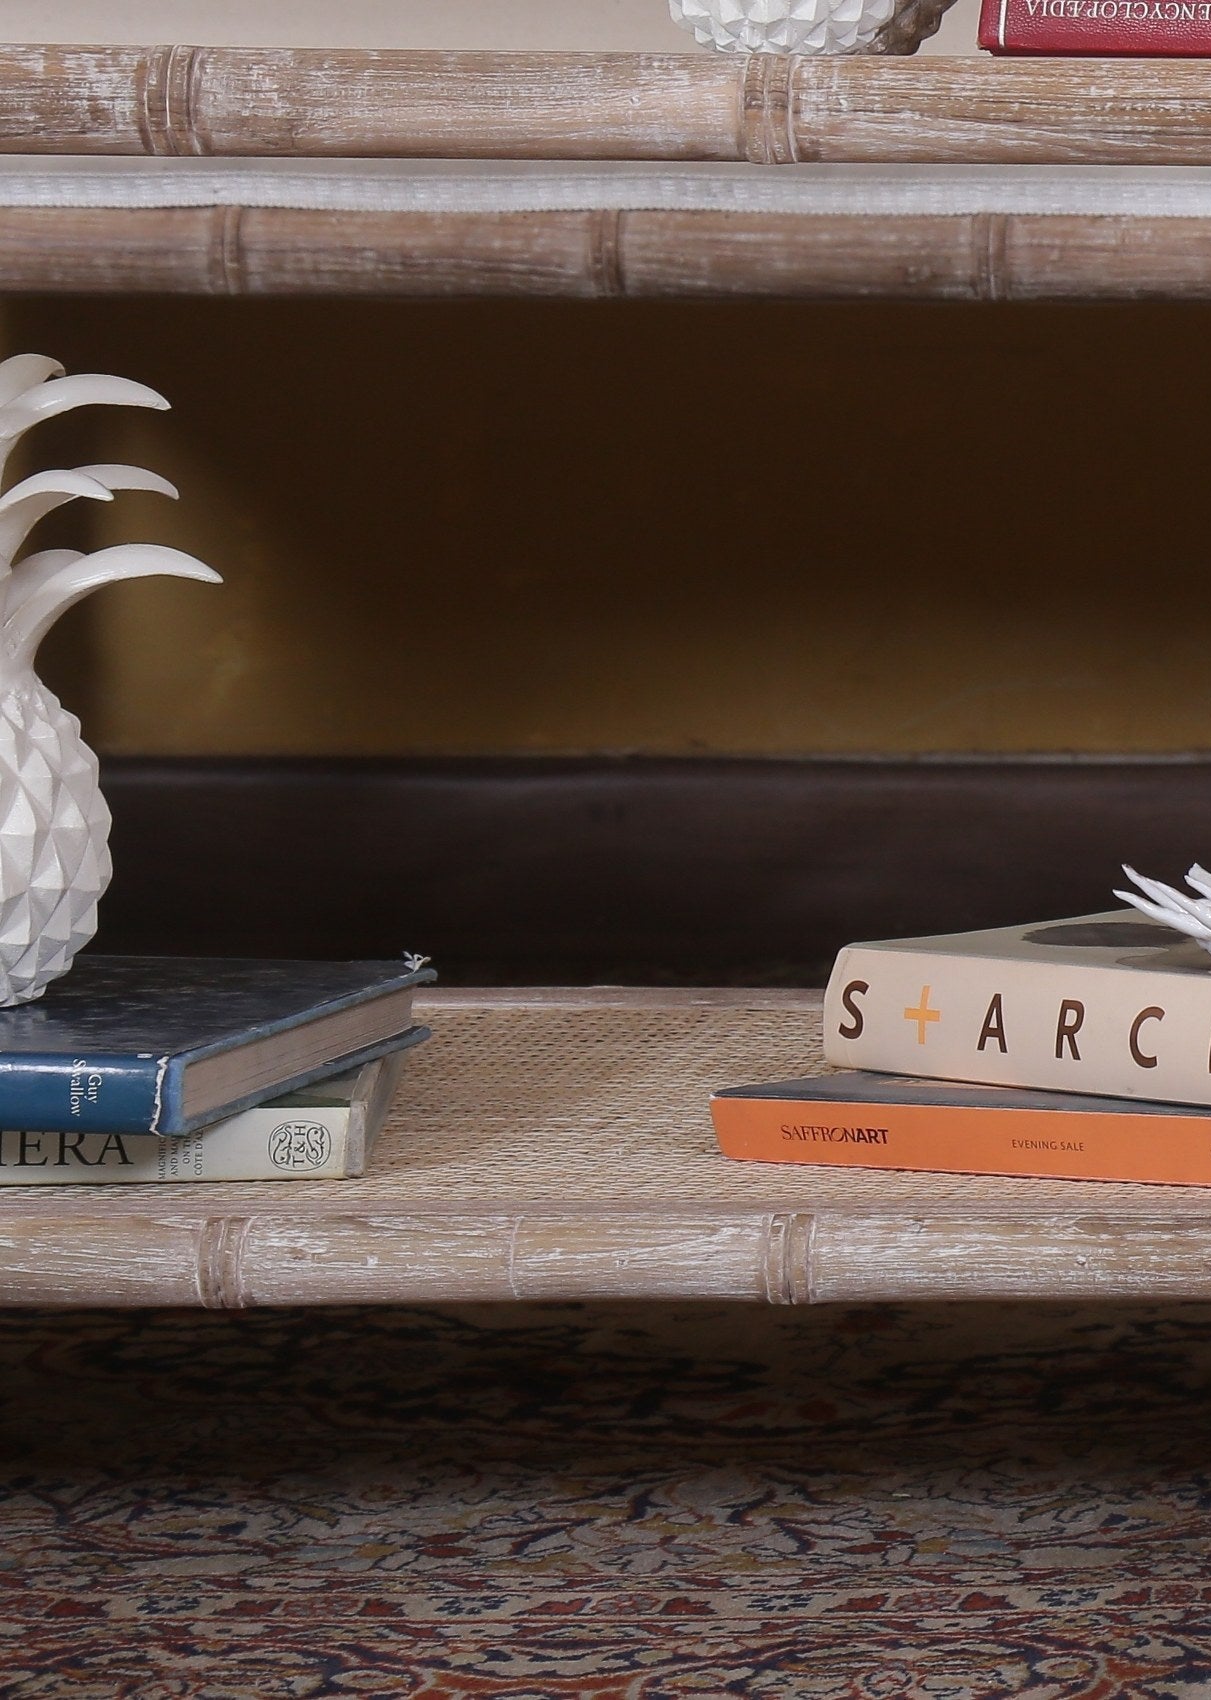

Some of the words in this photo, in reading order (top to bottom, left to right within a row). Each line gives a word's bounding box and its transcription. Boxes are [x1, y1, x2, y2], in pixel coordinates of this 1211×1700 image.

[1026, 0, 1211, 21] ENCYCLOPÆDIA
[69, 1058, 87, 1117] Swallow
[84, 1073, 103, 1104] Guy
[780, 1124, 889, 1145] SAFFRONART
[1011, 1139, 1058, 1151] EVENING
[1060, 1141, 1085, 1152] SALE
[170, 1157, 178, 1176] AND
[182, 1151, 191, 1164] ON
